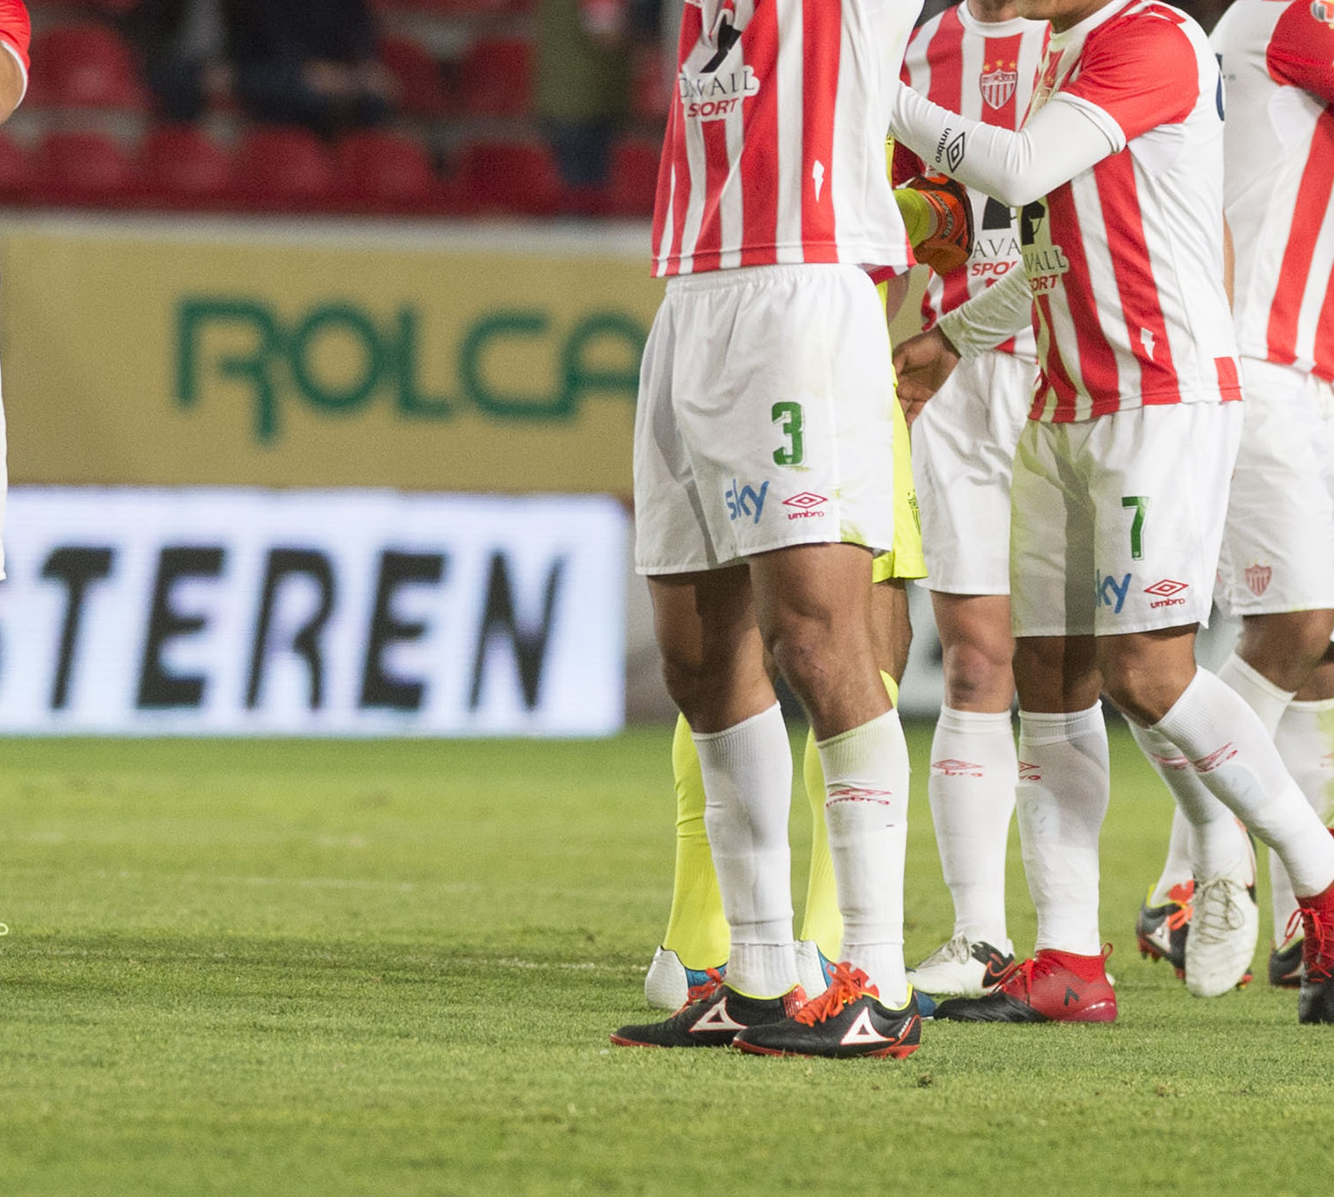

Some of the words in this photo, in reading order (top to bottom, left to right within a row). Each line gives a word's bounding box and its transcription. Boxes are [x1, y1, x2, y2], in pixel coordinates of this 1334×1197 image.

[688, 98, 739, 118] SORT
[935, 127, 952, 163] umbro
[175, 295, 645, 447] ROLCA
[771, 401, 804, 466] 3
[725, 478, 770, 524] sky
[788, 510, 825, 520] umbro
[1121, 496, 1152, 560] 7
[1096, 569, 1132, 614] ky
[1150, 598, 1186, 609] umbro
